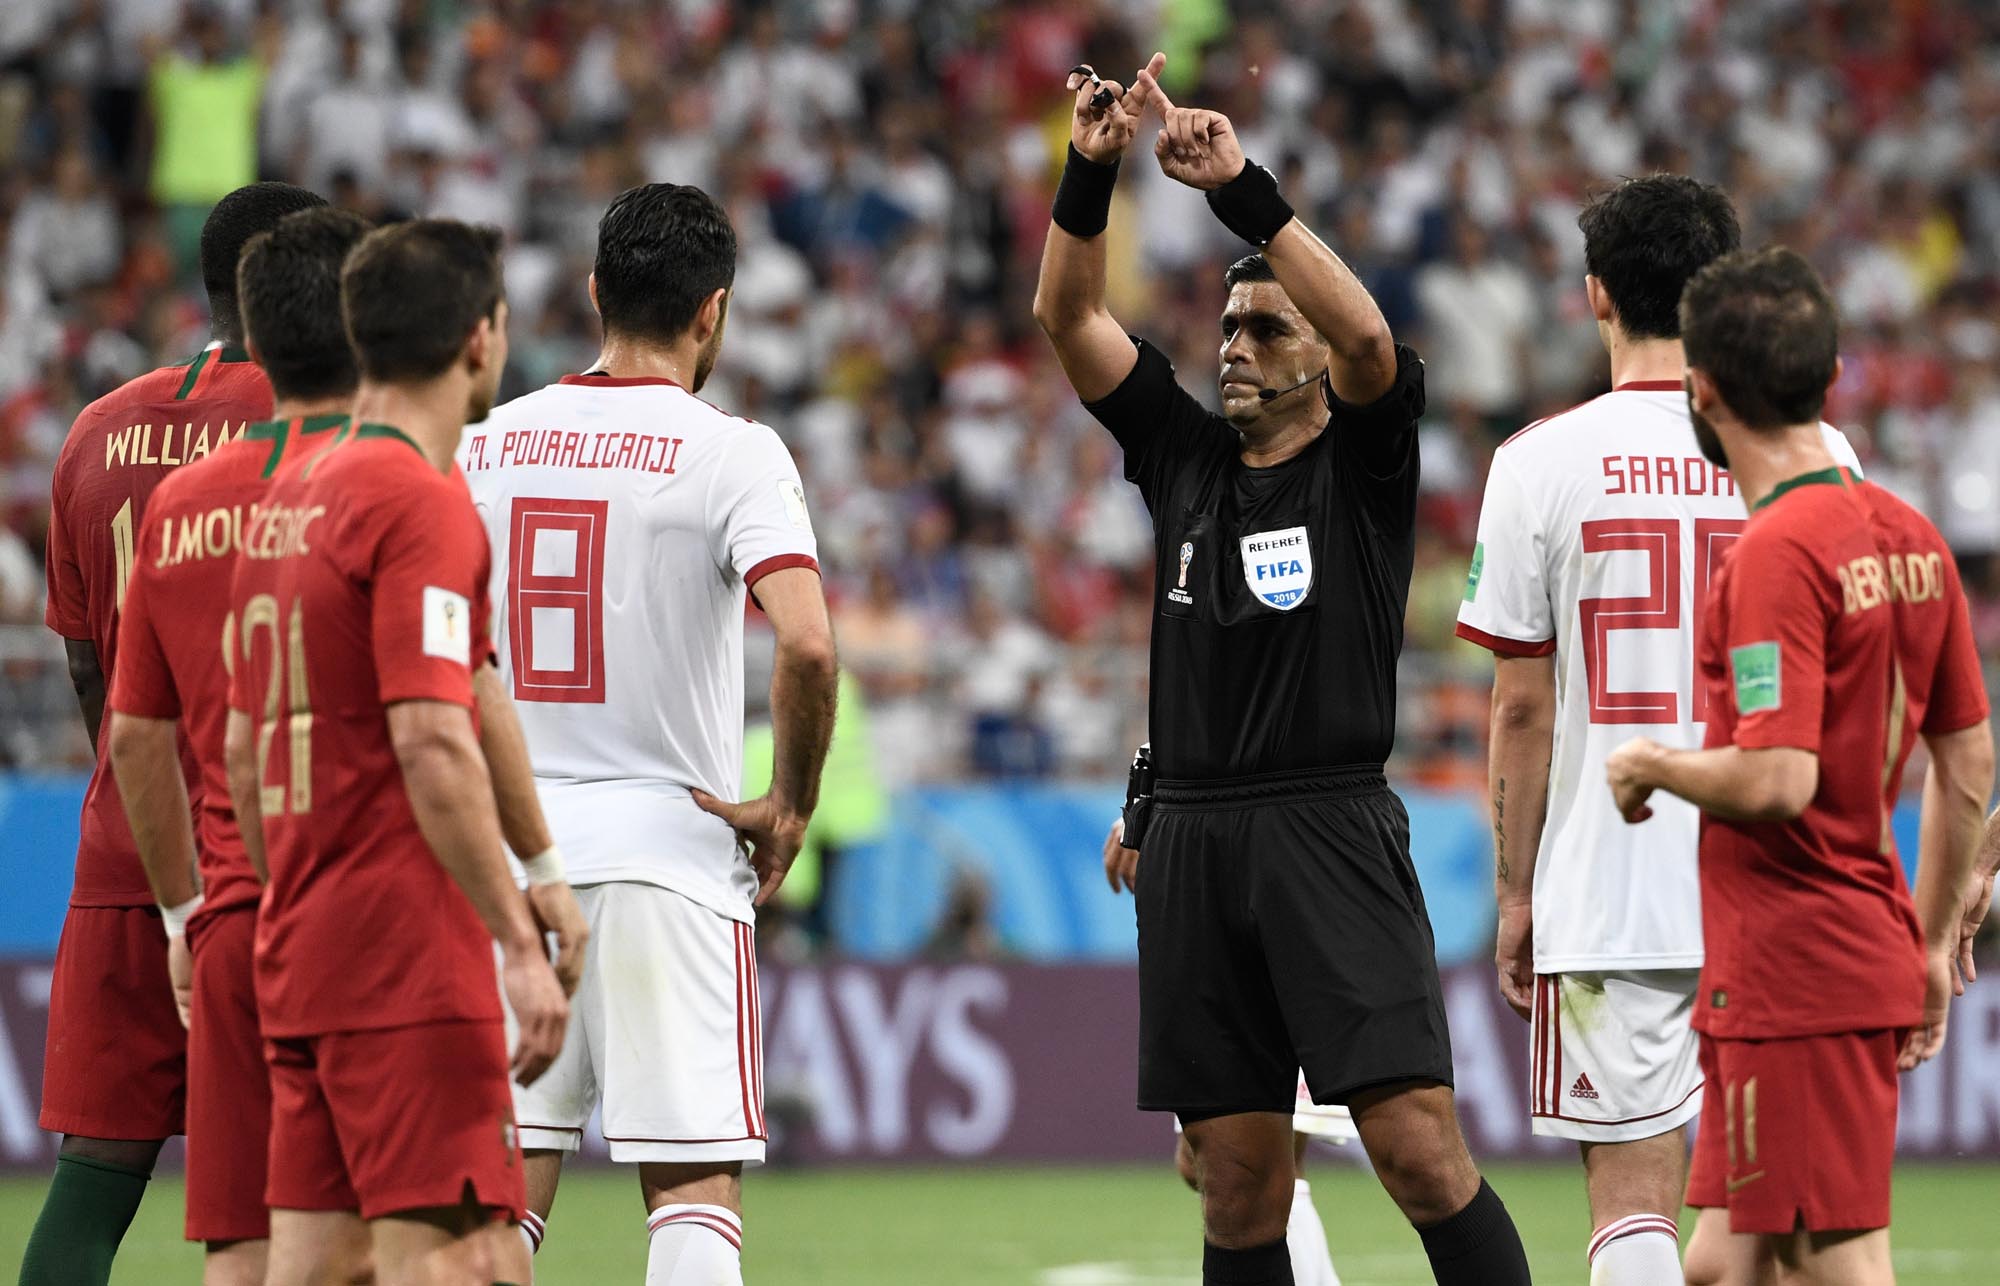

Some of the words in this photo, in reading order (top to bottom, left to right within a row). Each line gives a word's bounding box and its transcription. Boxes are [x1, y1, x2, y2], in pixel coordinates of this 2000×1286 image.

[467, 435, 490, 472] M.
[500, 429, 683, 475] POURALIGANJI
[1248, 535, 1304, 553] REFEREE
[1256, 559, 1304, 580] FIFA
[507, 496, 609, 704] 8
[1273, 592, 1297, 604] 2018
[241, 593, 314, 816] 21
[1569, 1089, 1600, 1100] adidas
[1725, 1076, 1757, 1164] 11
